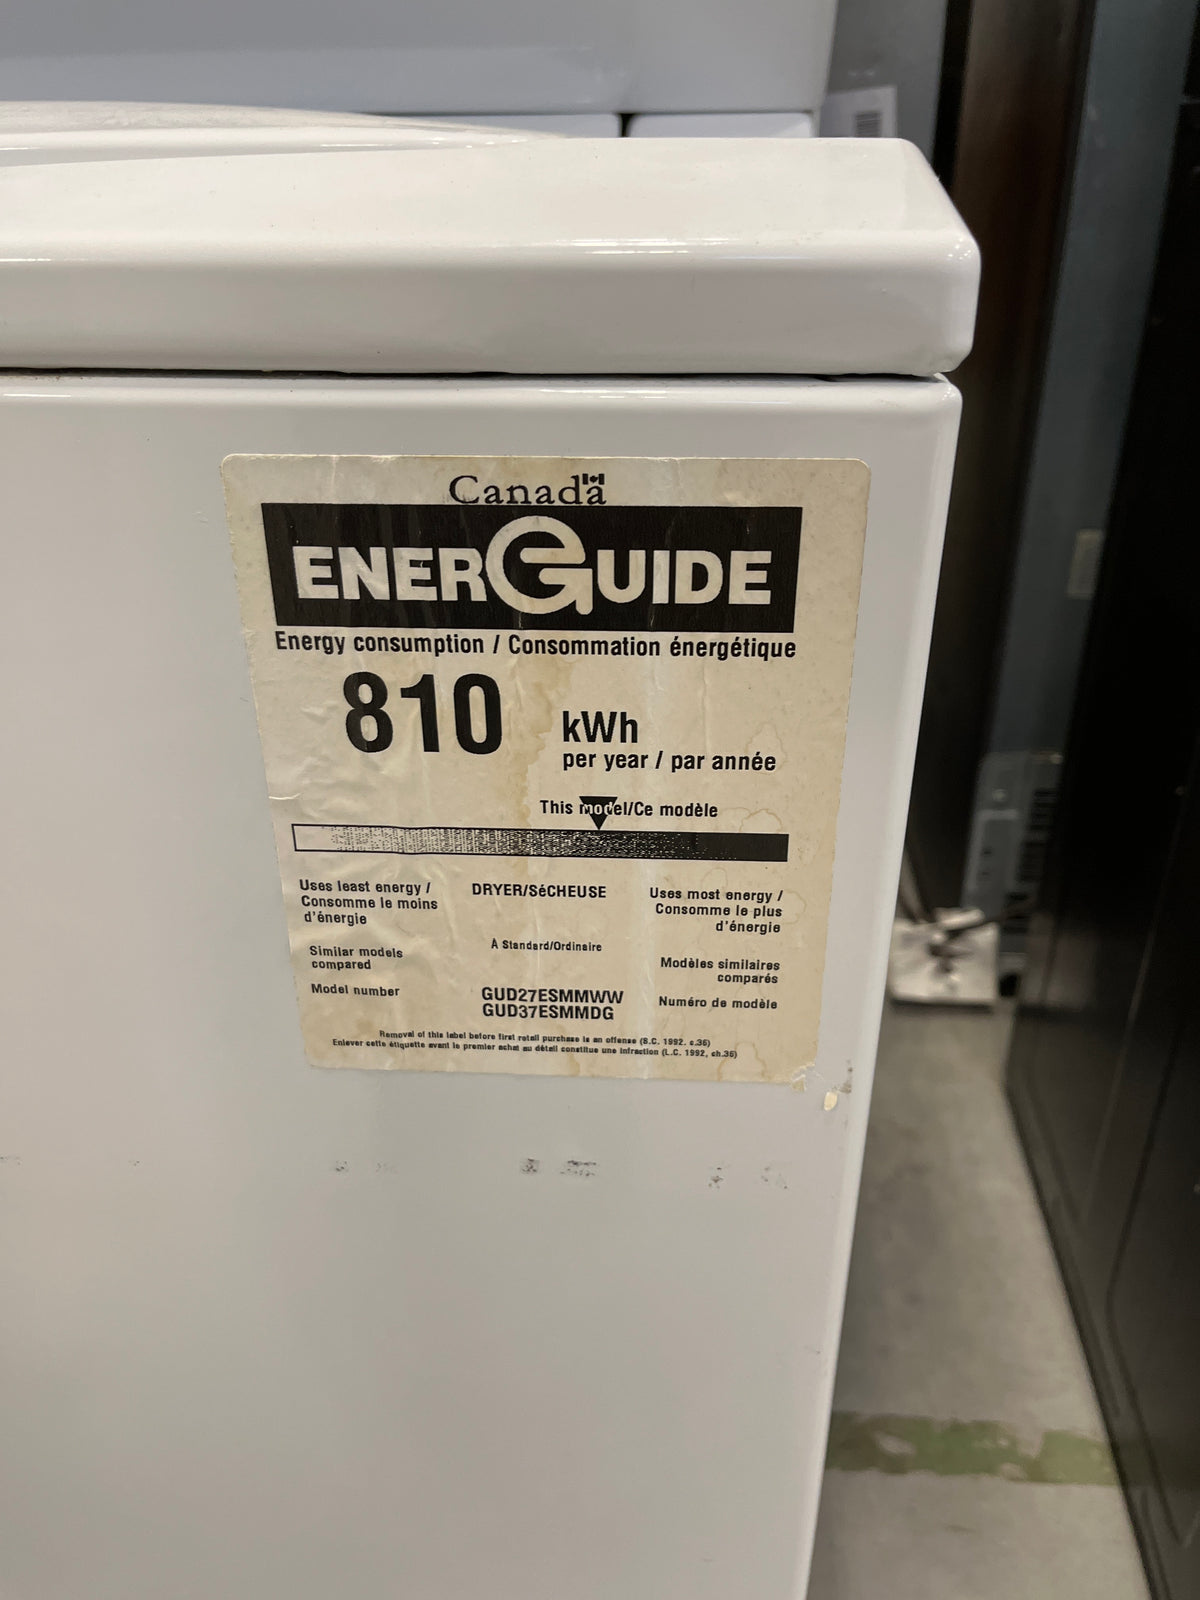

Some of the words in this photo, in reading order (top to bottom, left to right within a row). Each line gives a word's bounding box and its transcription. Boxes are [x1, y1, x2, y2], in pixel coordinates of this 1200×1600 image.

[449, 473, 607, 505] Canada
[292, 515, 772, 615] ENERGUIDE
[275, 631, 345, 655] Energy
[353, 634, 484, 657] consumption
[508, 635, 660, 657] Consommation
[670, 635, 797, 661] énergétique
[343, 671, 503, 755] 810
[562, 711, 639, 743] kWh
[562, 751, 596, 771] per
[604, 754, 648, 772] year
[671, 754, 704, 773] par
[711, 752, 777, 772] année
[540, 800, 573, 815] This
[579, 801, 653, 817] model/Ce
[660, 803, 718, 818] modèle
[299, 879, 333, 892] Uses
[337, 880, 371, 893] least
[375, 883, 422, 896] energy
[472, 883, 607, 899] DRYER/SéCHEUSE
[650, 887, 682, 900] Uses
[687, 889, 721, 901] most
[725, 891, 773, 904] energy
[301, 895, 376, 909] Consomme
[380, 897, 393, 909] le
[397, 897, 438, 910] moins
[304, 911, 367, 927] d'énergie
[655, 903, 731, 917] Consomme
[736, 905, 748, 917] le
[753, 905, 783, 919] plus
[715, 920, 781, 935] d'énergie
[309, 945, 354, 957] Similar
[359, 947, 404, 959] models
[502, 939, 602, 952] Standard/Ordinaire
[311, 959, 372, 971] compared
[660, 957, 714, 969] Modèles
[718, 958, 781, 972] similaires
[717, 973, 779, 985] comparés
[311, 983, 349, 995] Model
[353, 985, 400, 997] number
[481, 986, 624, 1004] GUD27ESMMWW
[659, 995, 707, 1008] Numéro
[712, 997, 727, 1008] de
[732, 998, 778, 1010] modèle
[482, 1003, 614, 1020] GUD37ESMMDG
[379, 1030, 415, 1039] Removal
[417, 1030, 426, 1039] of
[428, 1031, 444, 1039] this
[446, 1031, 466, 1040] label
[469, 1032, 496, 1041] before
[498, 1033, 516, 1041] first
[518, 1034, 540, 1042] retail
[542, 1034, 580, 1043] purchase
[582, 1035, 590, 1043] is
[593, 1036, 603, 1044] an
[605, 1035, 637, 1045] offense
[333, 1038, 363, 1047] Enlever
[366, 1038, 387, 1047] cette
[389, 1039, 426, 1050] étiquette
[463, 1043, 496, 1052] premier
[535, 1044, 558, 1052] détail
[561, 1045, 599, 1054] constitue
[619, 1046, 659, 1056] infraction
[661, 1047, 682, 1057] (L.C.
